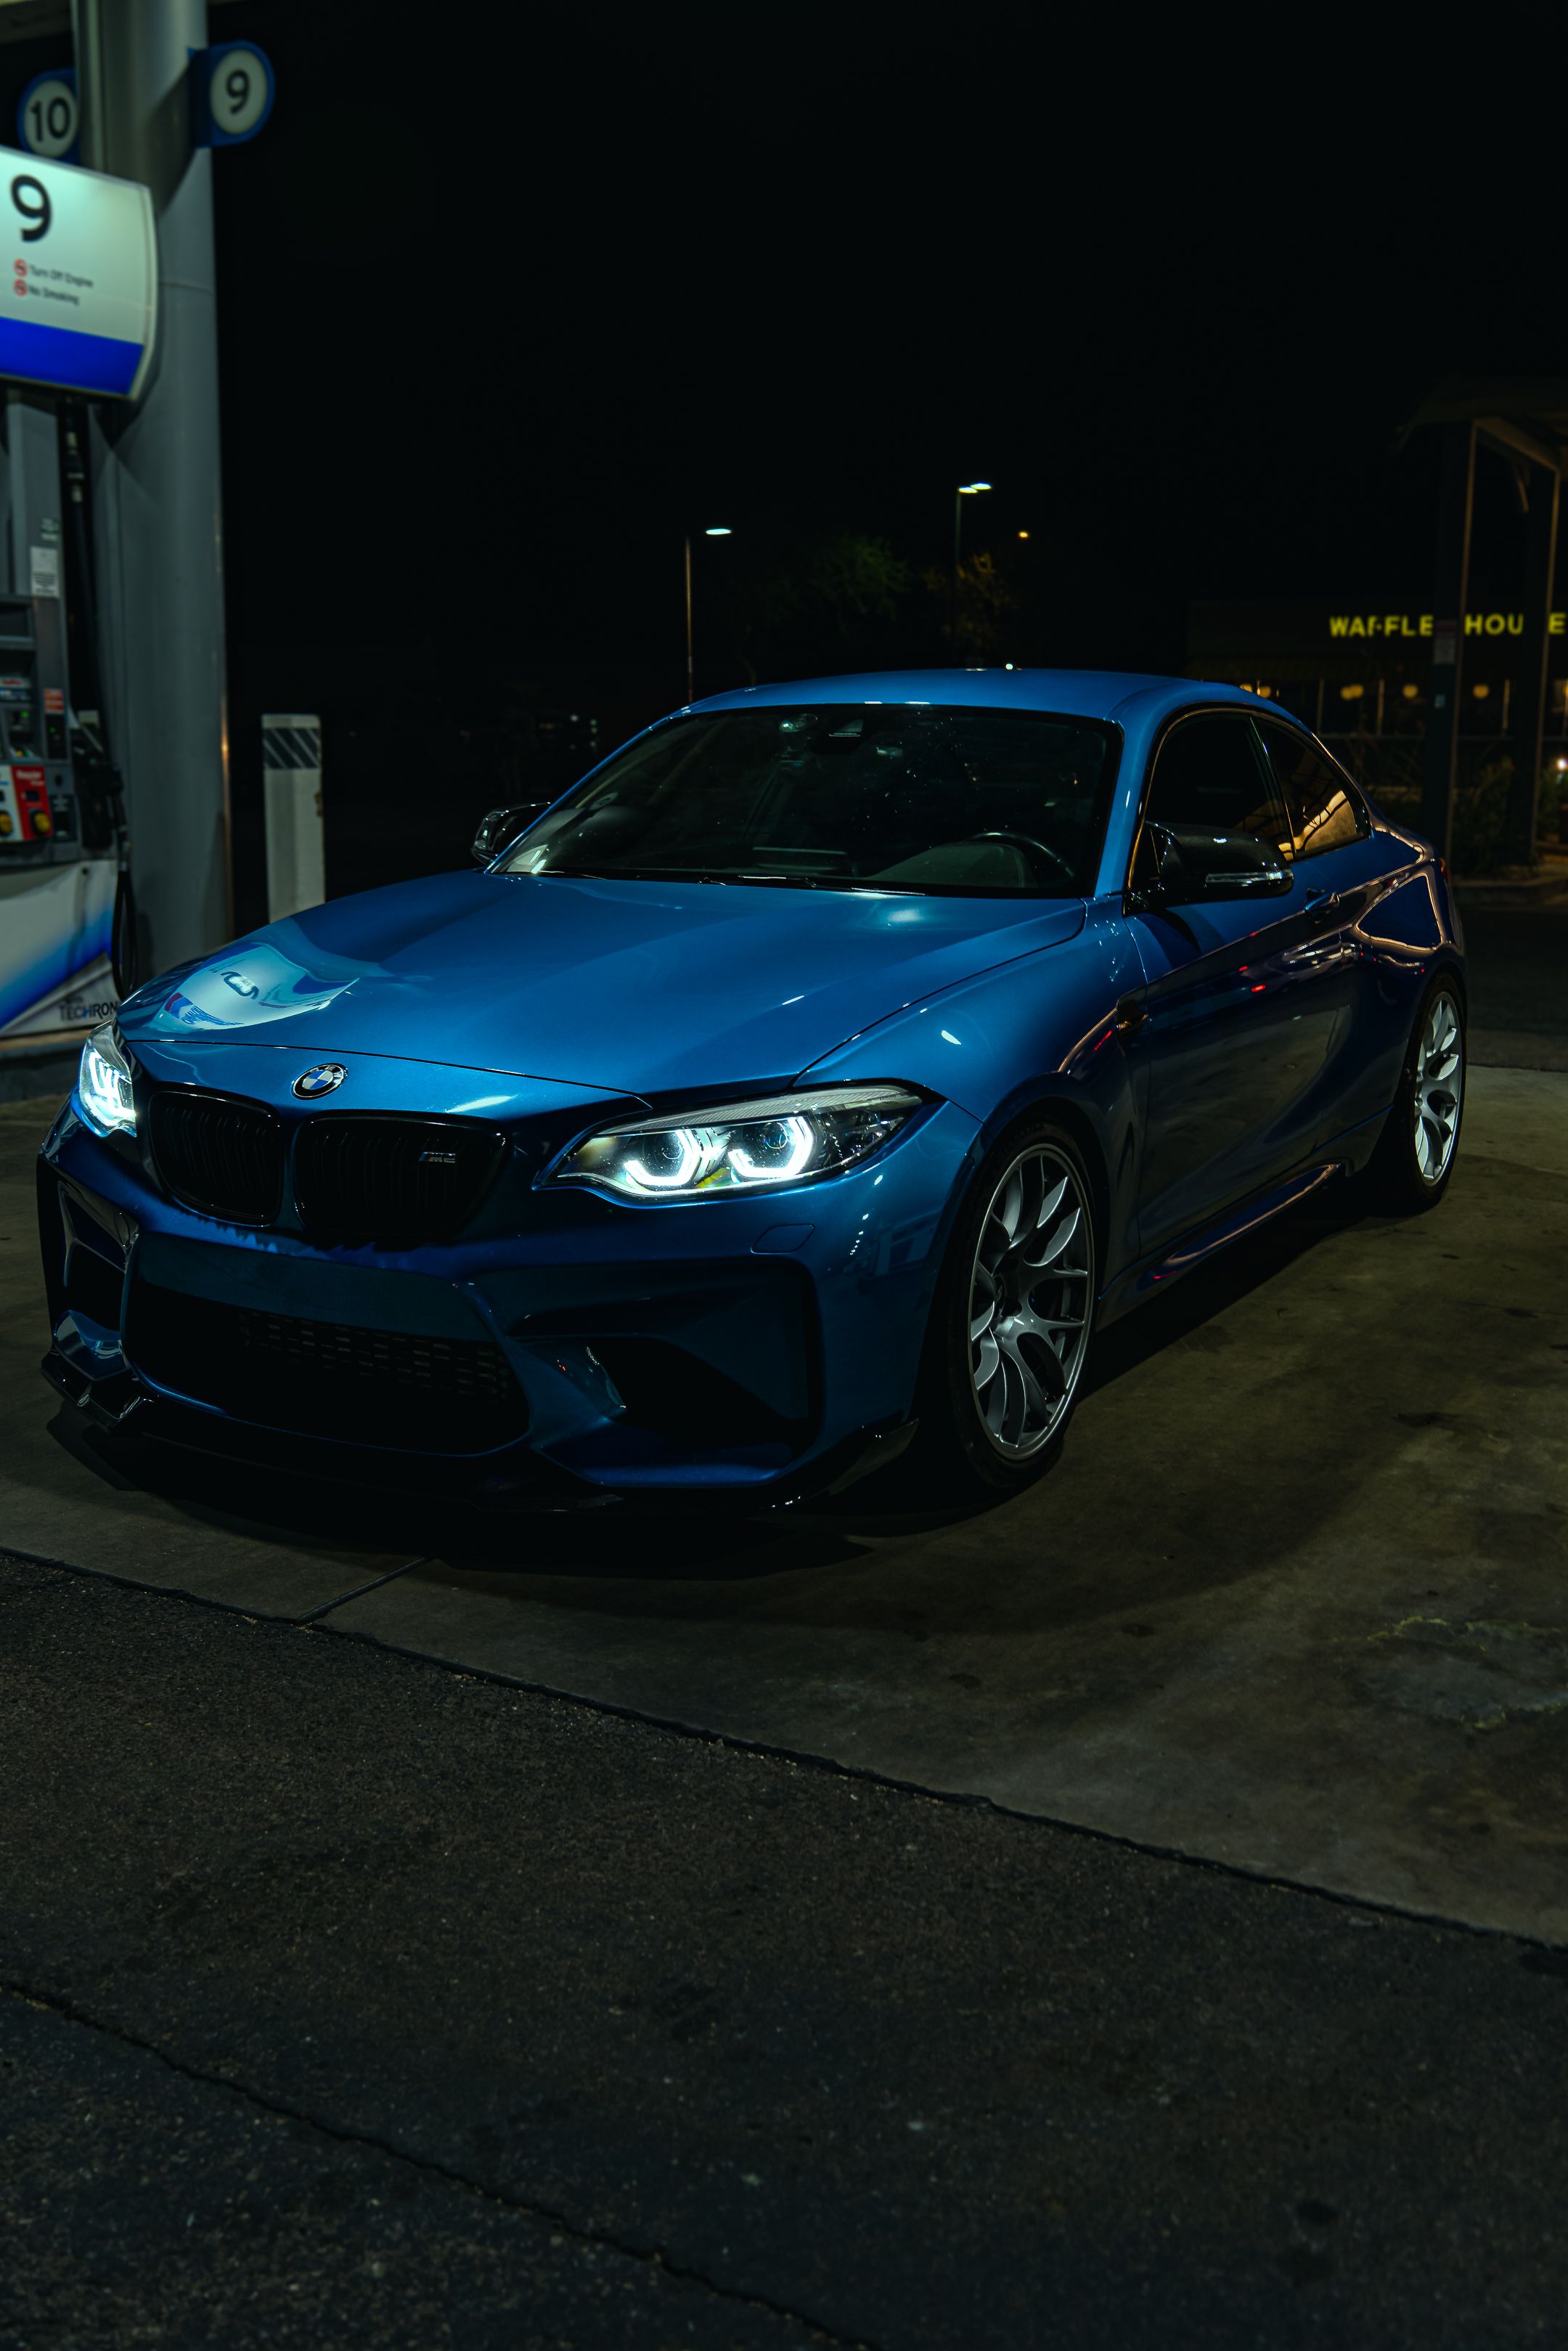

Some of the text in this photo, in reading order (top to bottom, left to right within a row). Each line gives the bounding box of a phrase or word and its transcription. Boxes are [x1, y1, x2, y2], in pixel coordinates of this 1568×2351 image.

[225, 69, 250, 115] 9
[30, 97, 70, 142] 10
[10, 175, 52, 243] 9
[1463, 614, 1567, 636] HOUE
